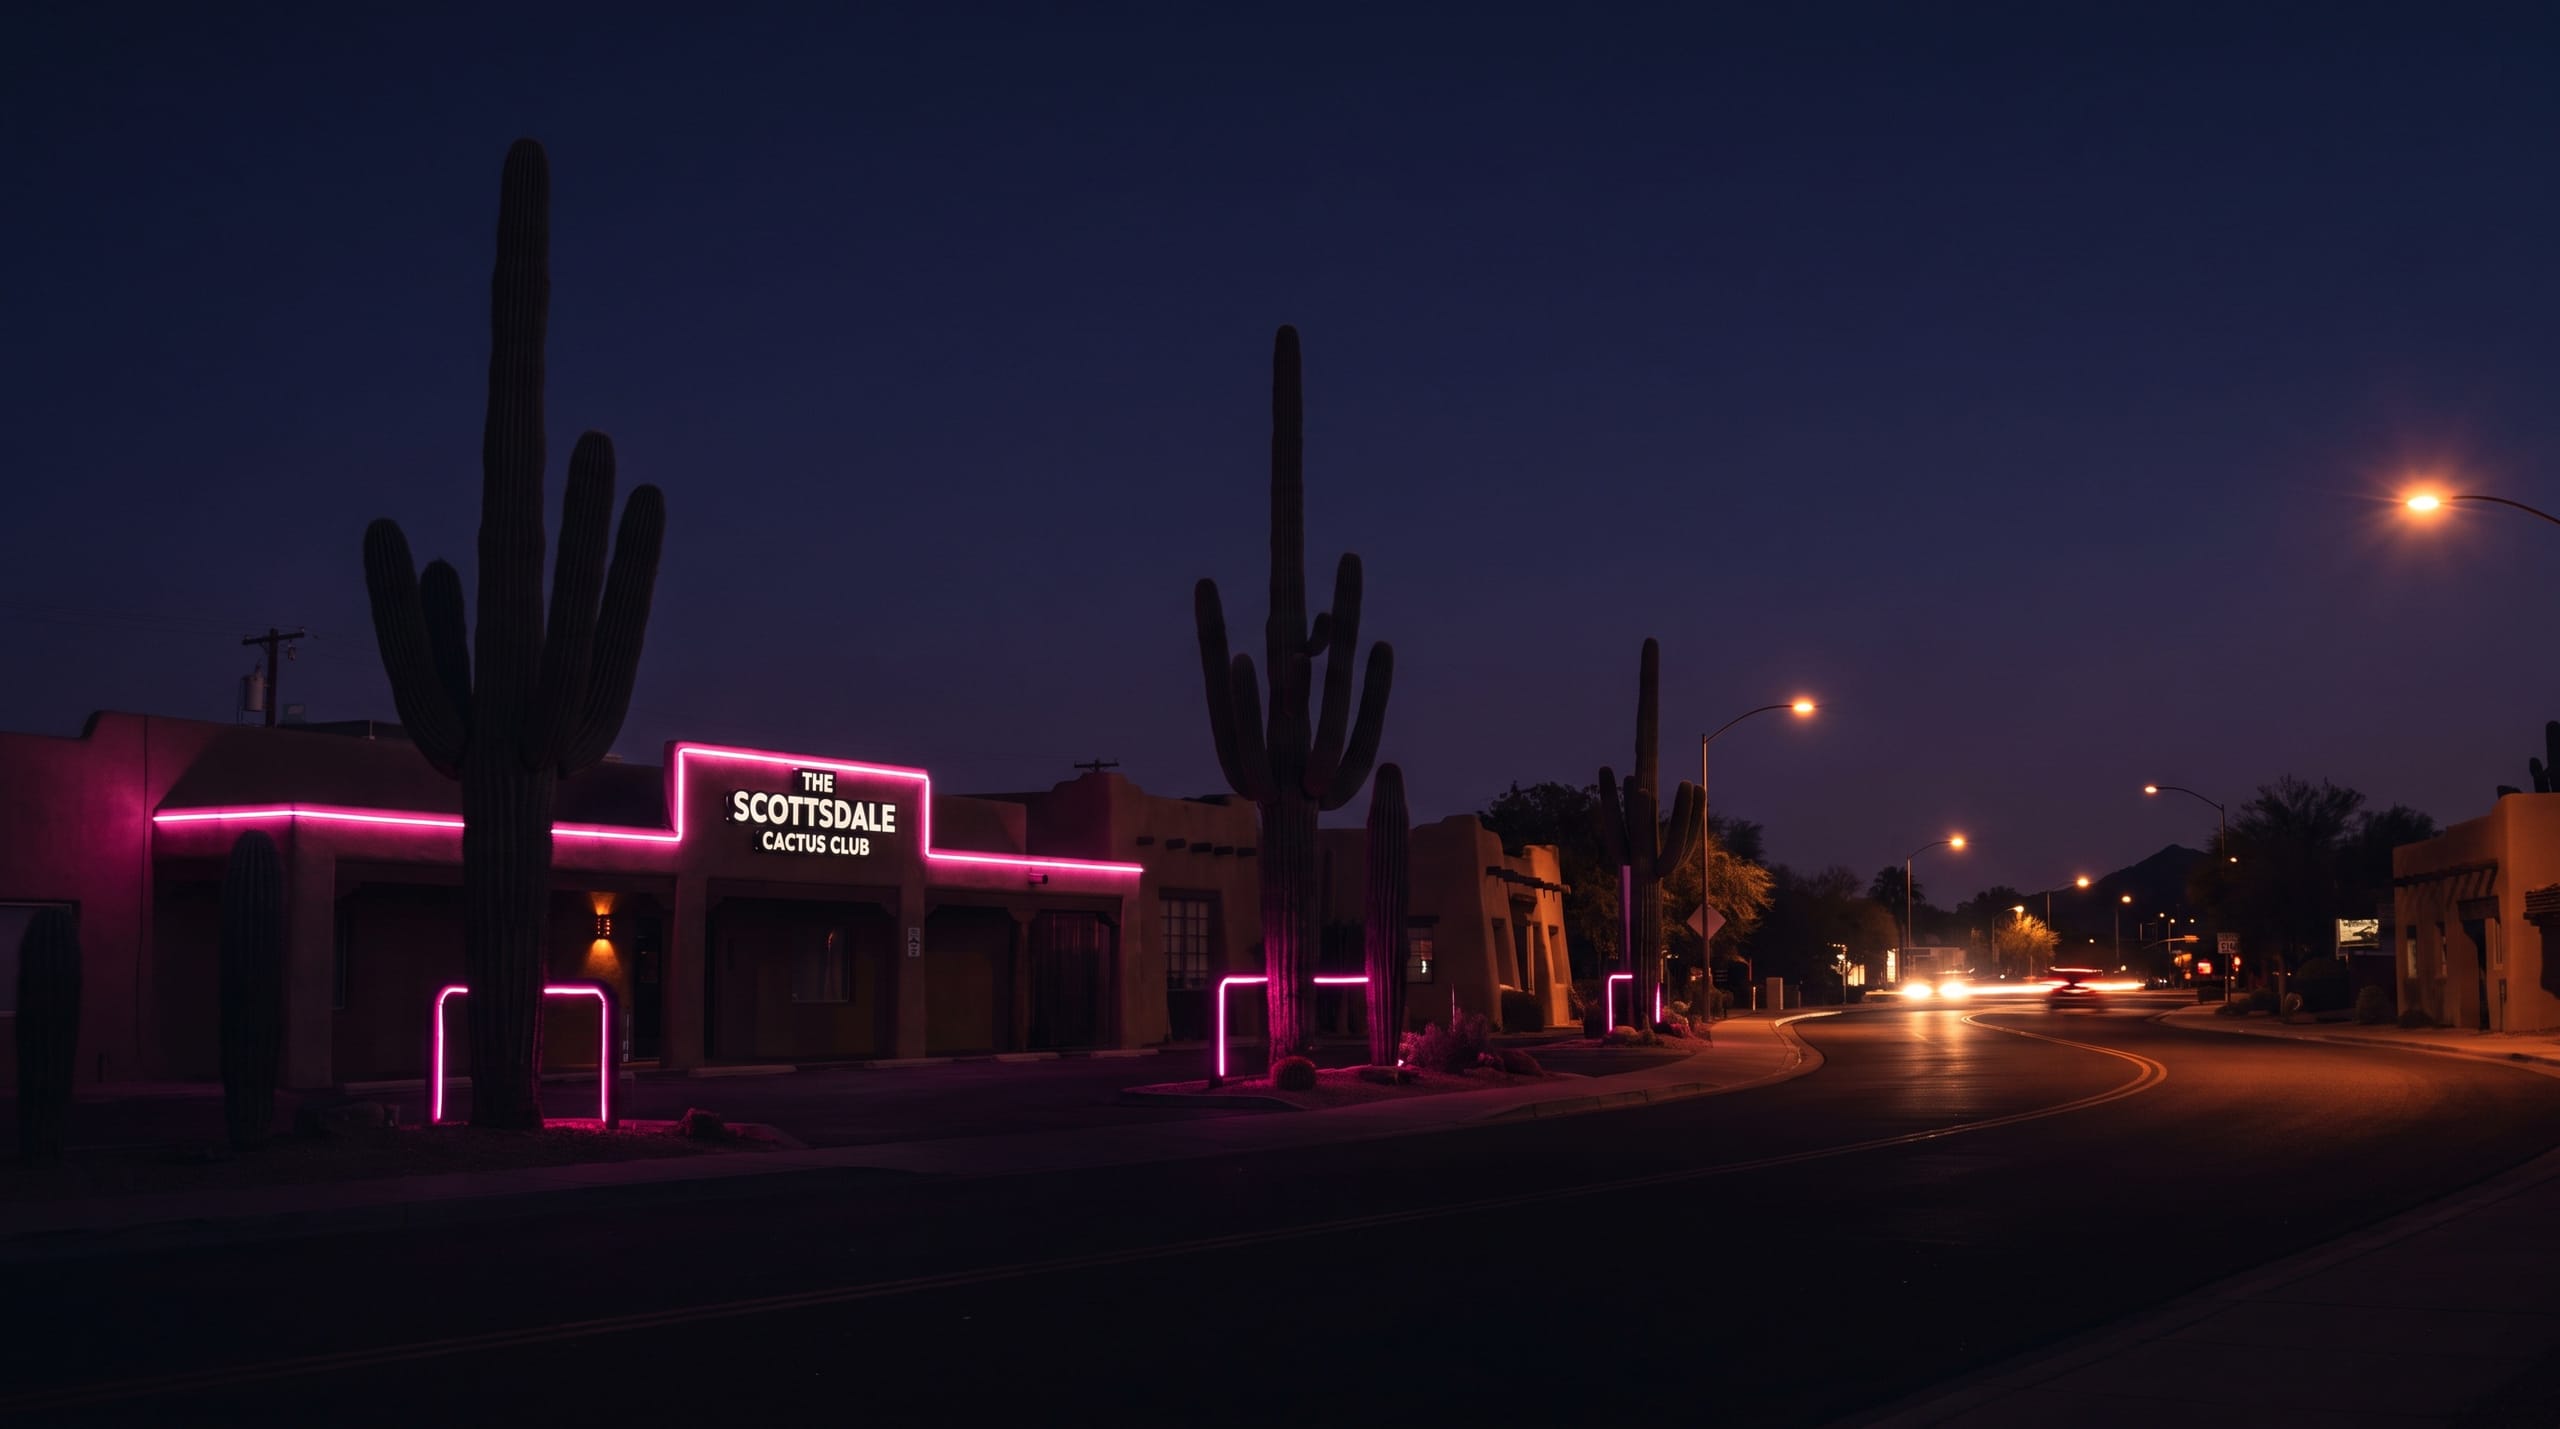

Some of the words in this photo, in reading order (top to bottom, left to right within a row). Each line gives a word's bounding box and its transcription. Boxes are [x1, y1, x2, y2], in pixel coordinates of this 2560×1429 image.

[802, 772, 834, 793] THE
[733, 790, 896, 833] SCOTTSDALE
[762, 831, 826, 854] CACTUS
[830, 836, 870, 856] CLUB
